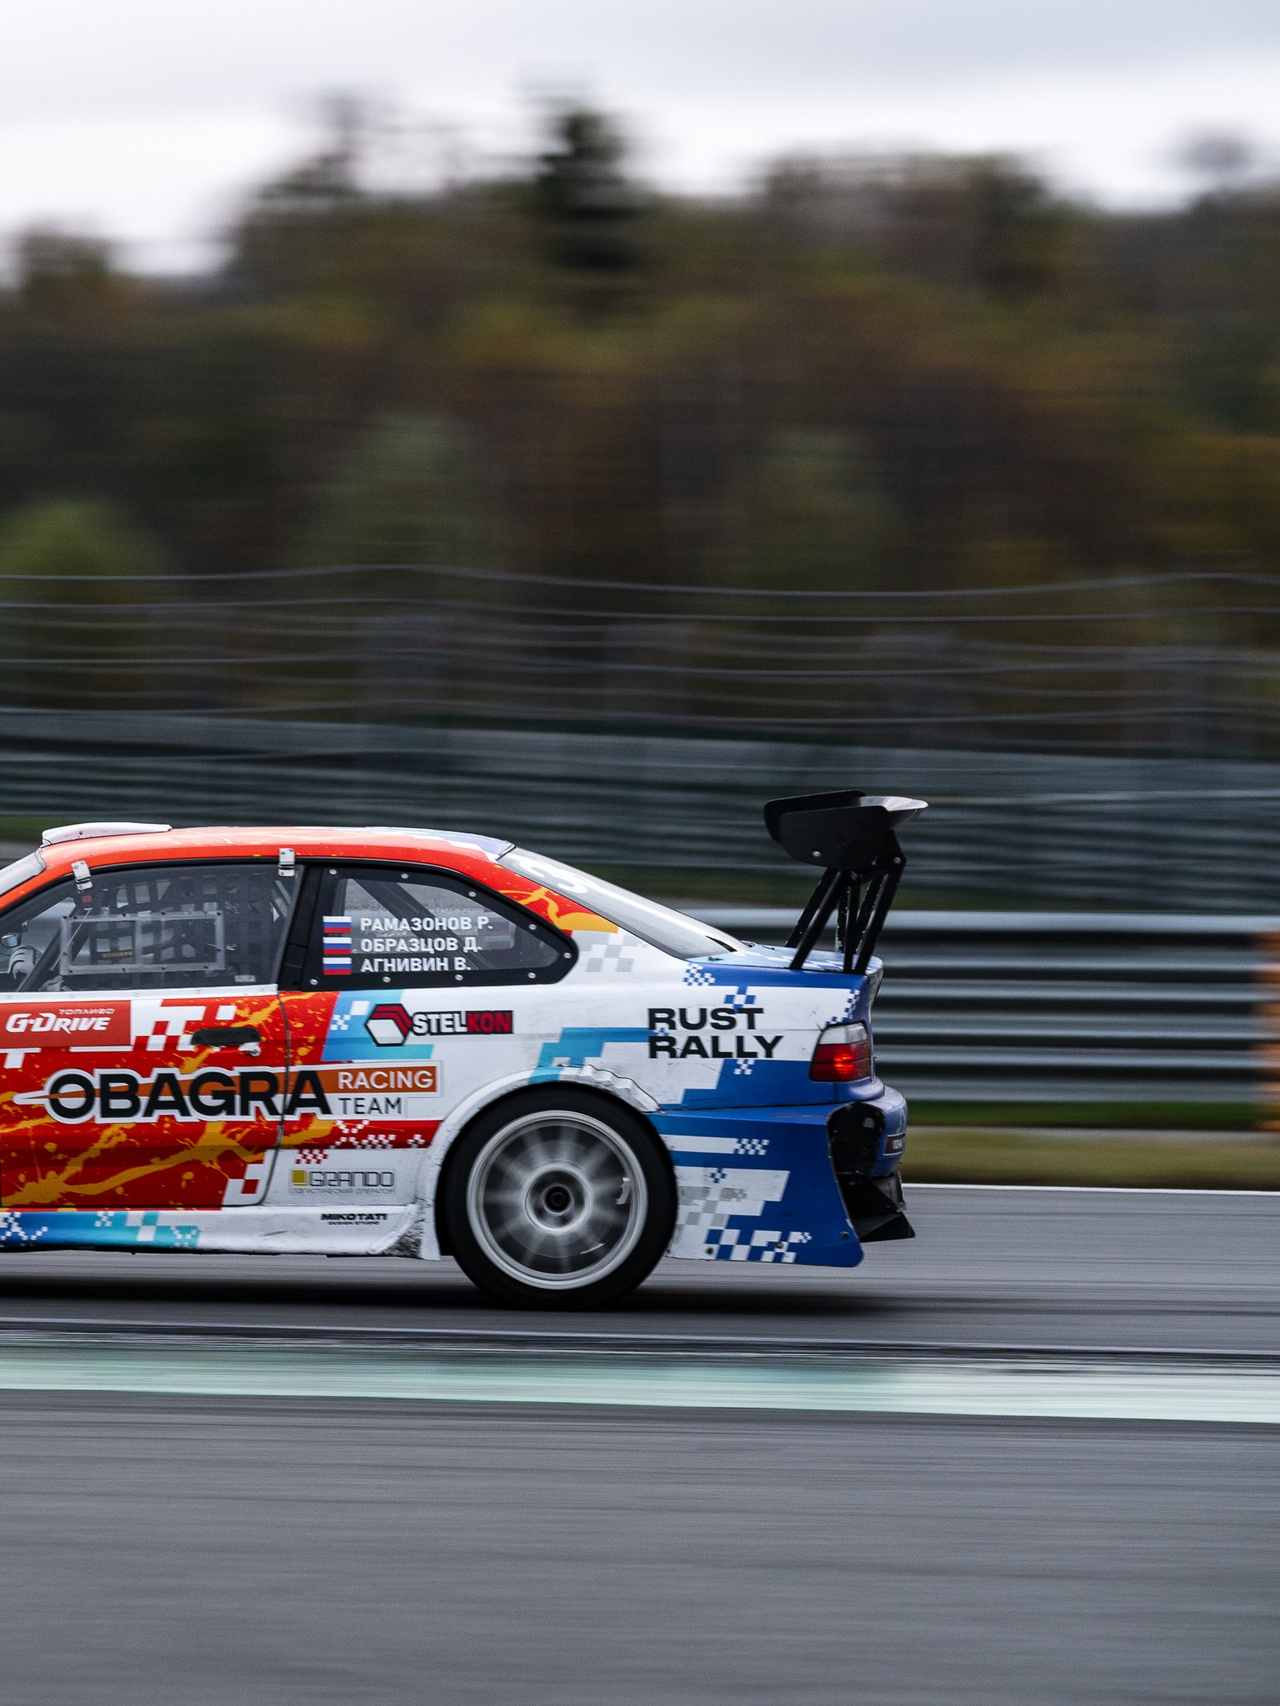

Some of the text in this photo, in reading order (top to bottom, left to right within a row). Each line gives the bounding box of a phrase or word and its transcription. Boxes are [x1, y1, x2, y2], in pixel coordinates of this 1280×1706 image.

[360, 915, 494, 932] РАМАЗОНОВ Р.
[360, 936, 483, 954] ОБРАЗЦОВ Д.
[360, 957, 472, 973] АГНИВИН В.
[412, 1011, 512, 1035] STELKON
[648, 1007, 764, 1031] RUST
[648, 1035, 785, 1059] RALLY
[337, 1070, 434, 1090] RACING
[48, 1069, 333, 1118] OBAGRA
[337, 1096, 402, 1115] TEAM
